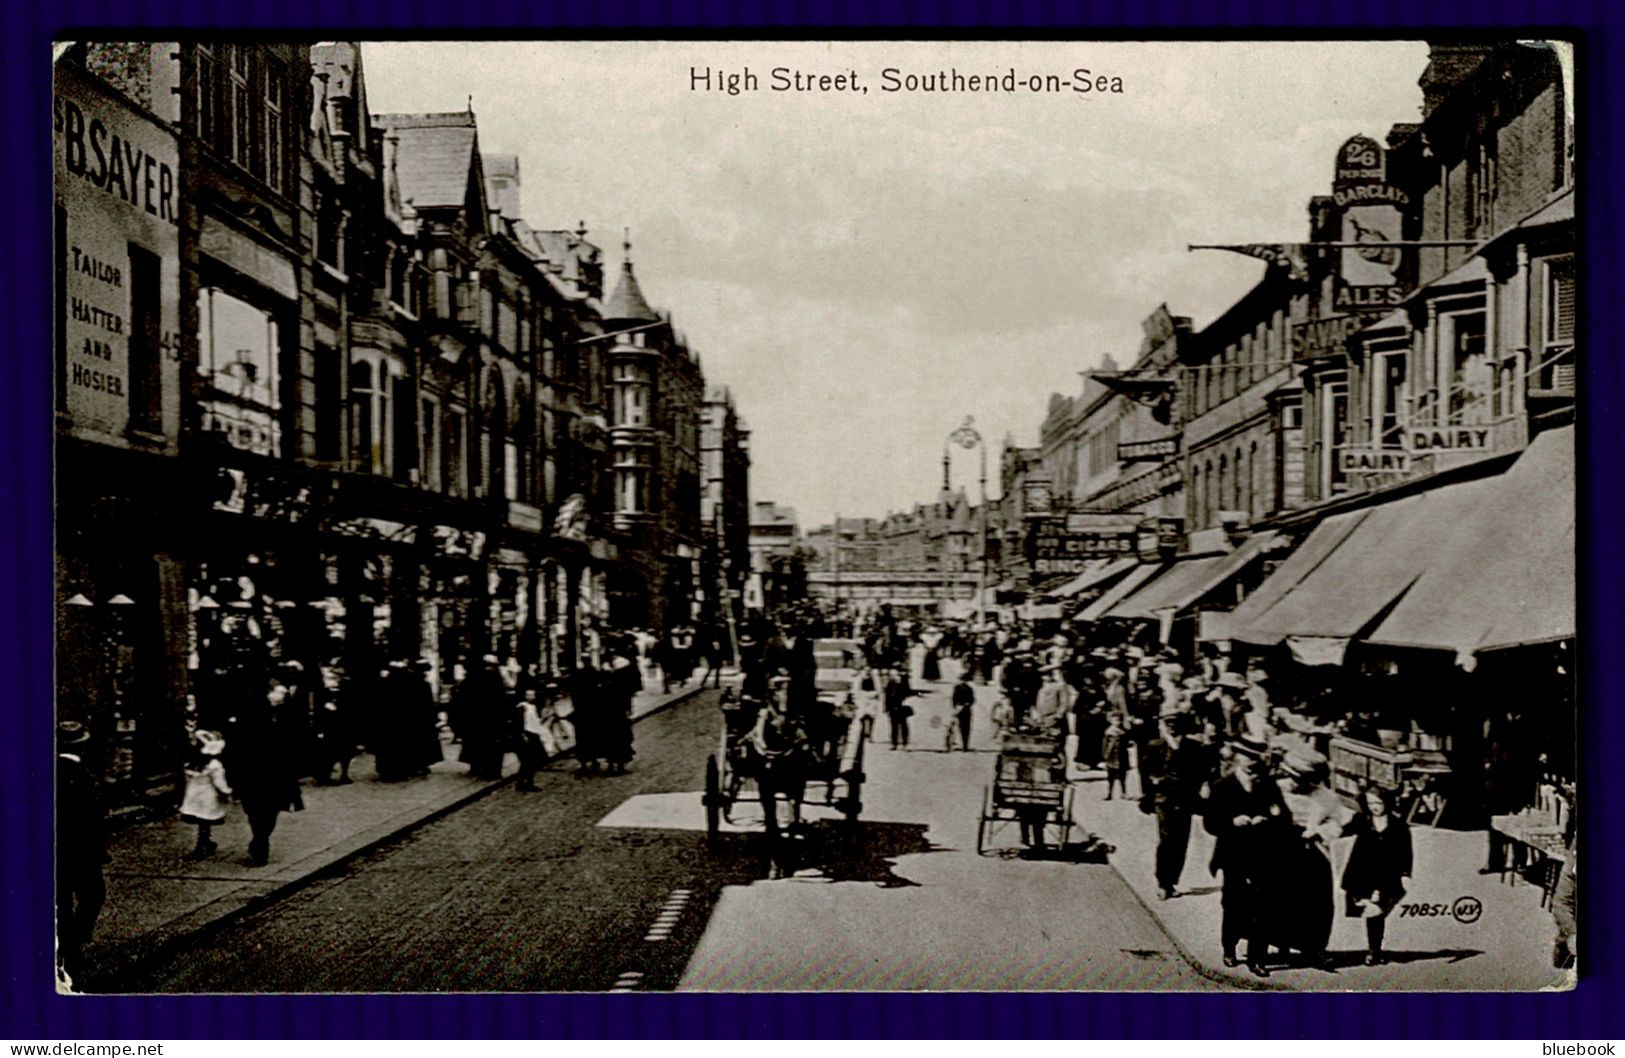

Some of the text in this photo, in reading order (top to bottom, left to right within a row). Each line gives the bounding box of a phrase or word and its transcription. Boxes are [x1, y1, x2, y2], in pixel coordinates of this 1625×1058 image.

[1336, 287, 1403, 305] ALES
[71, 297, 123, 334] HATTER
[83, 338, 112, 361] AND
[1414, 430, 1488, 449] DAIRY
[1345, 454, 1406, 469] DAIRY
